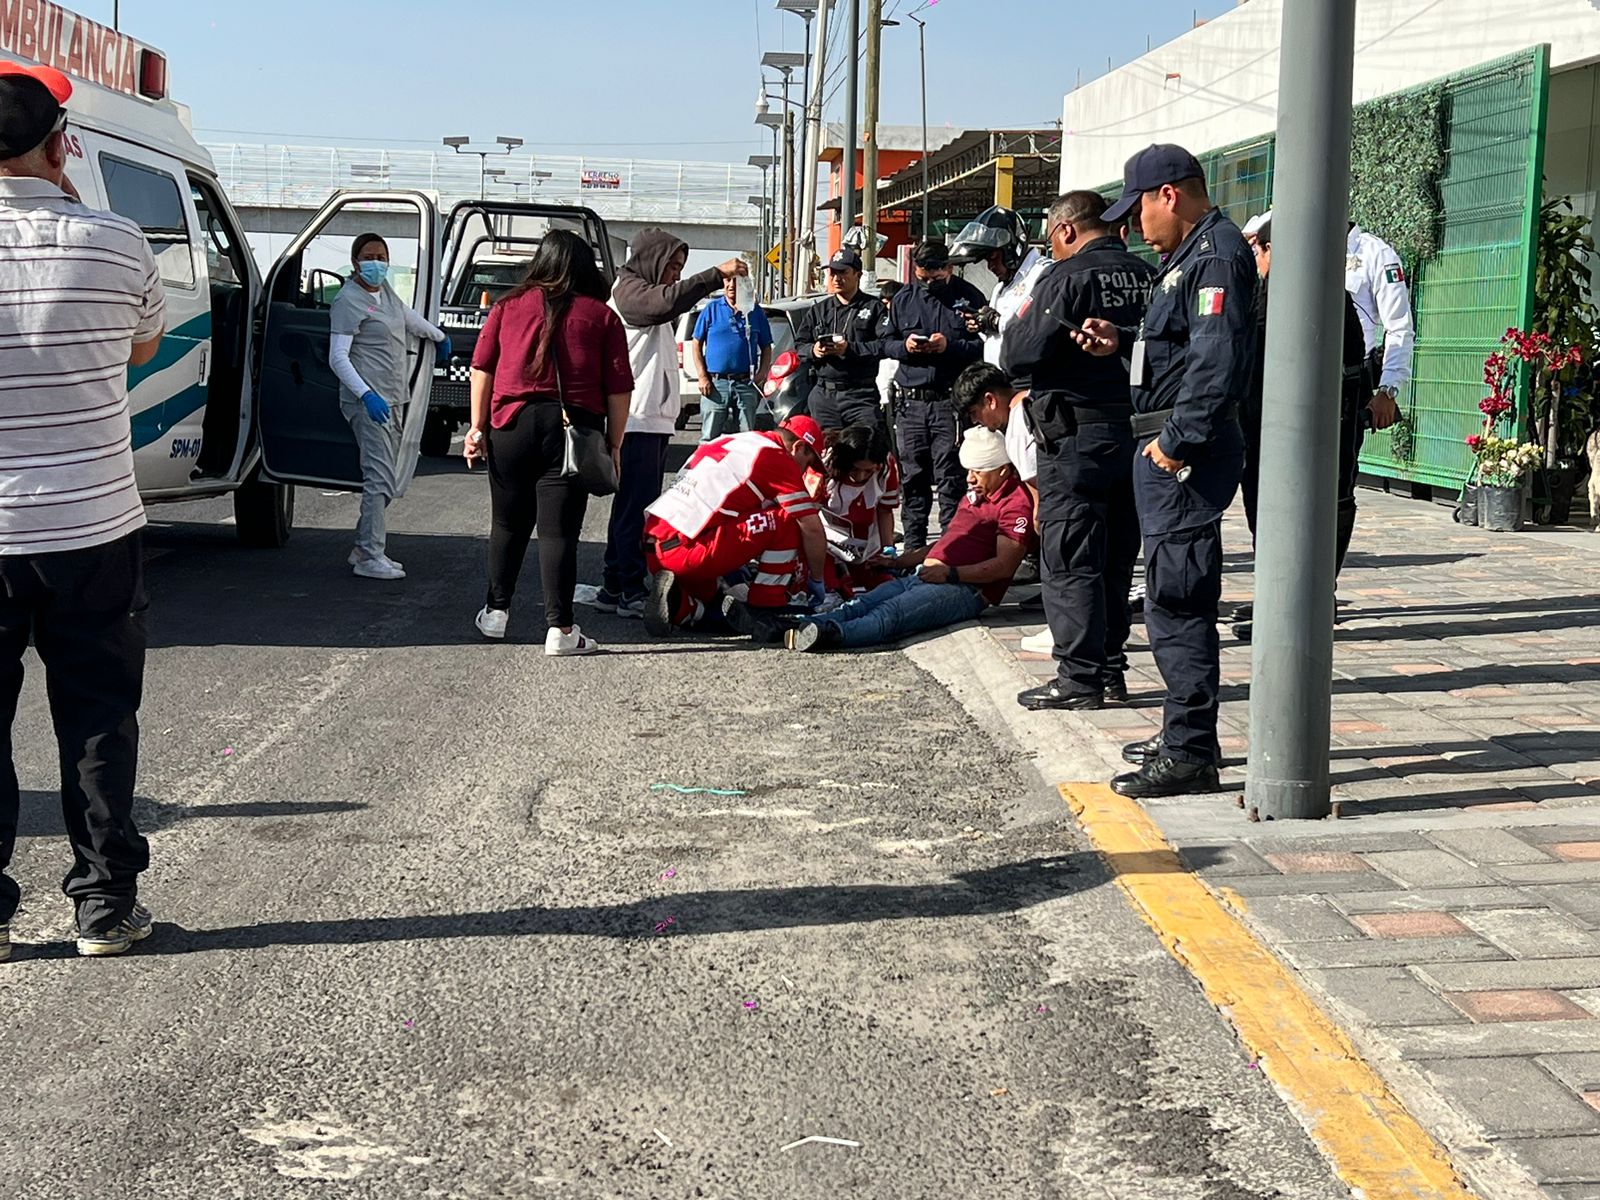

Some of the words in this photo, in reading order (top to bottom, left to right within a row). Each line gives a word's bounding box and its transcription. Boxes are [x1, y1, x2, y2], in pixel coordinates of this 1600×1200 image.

[0, 0, 136, 95] MBULANCIA
[63, 132, 83, 158] AS
[1013, 517, 1028, 533] 2
